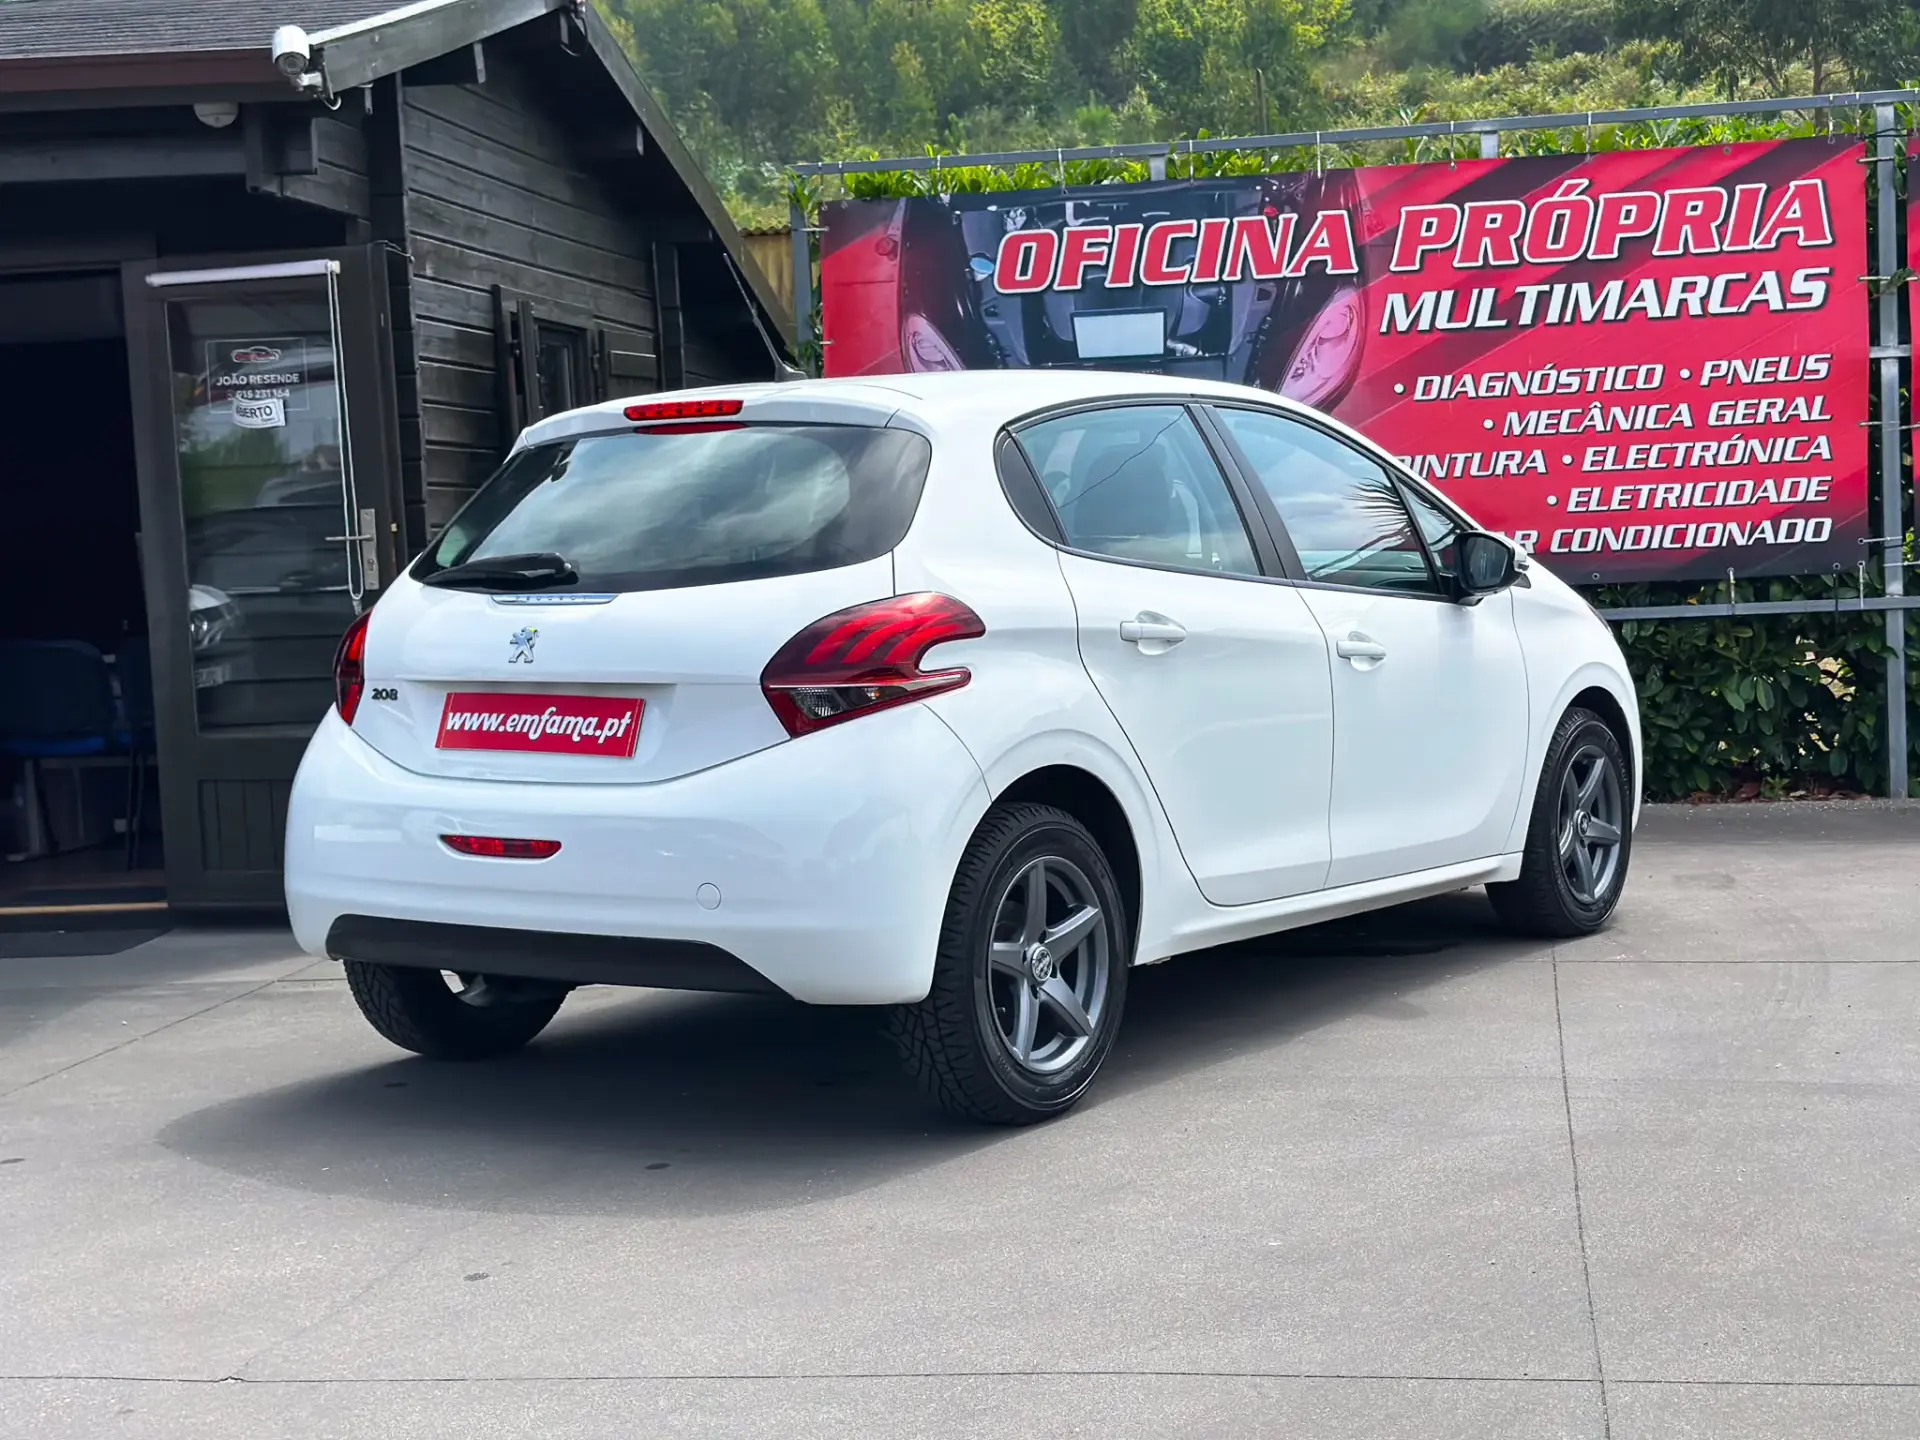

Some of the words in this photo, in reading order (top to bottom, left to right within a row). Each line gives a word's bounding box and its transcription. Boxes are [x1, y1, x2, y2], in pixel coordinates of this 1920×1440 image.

[994, 209, 1359, 294] OFICINA
[1390, 178, 1833, 271] PRÓPRIA
[1379, 267, 1831, 333] MULTIMARCAS
[216, 373, 247, 386] JOÃO
[249, 374, 300, 385] RESENDE
[1413, 364, 1664, 401] DIAGNÓSTICO
[1700, 354, 1832, 387] PNEUS
[1503, 401, 1693, 436] MECÂNICA
[1707, 396, 1832, 427] GERAL
[1581, 433, 1832, 473] ELECTRÓNICA
[1566, 476, 1832, 512] ELETRICIDADE
[1497, 529, 1539, 554] R
[1550, 518, 1833, 553] CONDICIONADO
[371, 688, 398, 701] 208
[446, 707, 632, 744] www.emfama.pt
